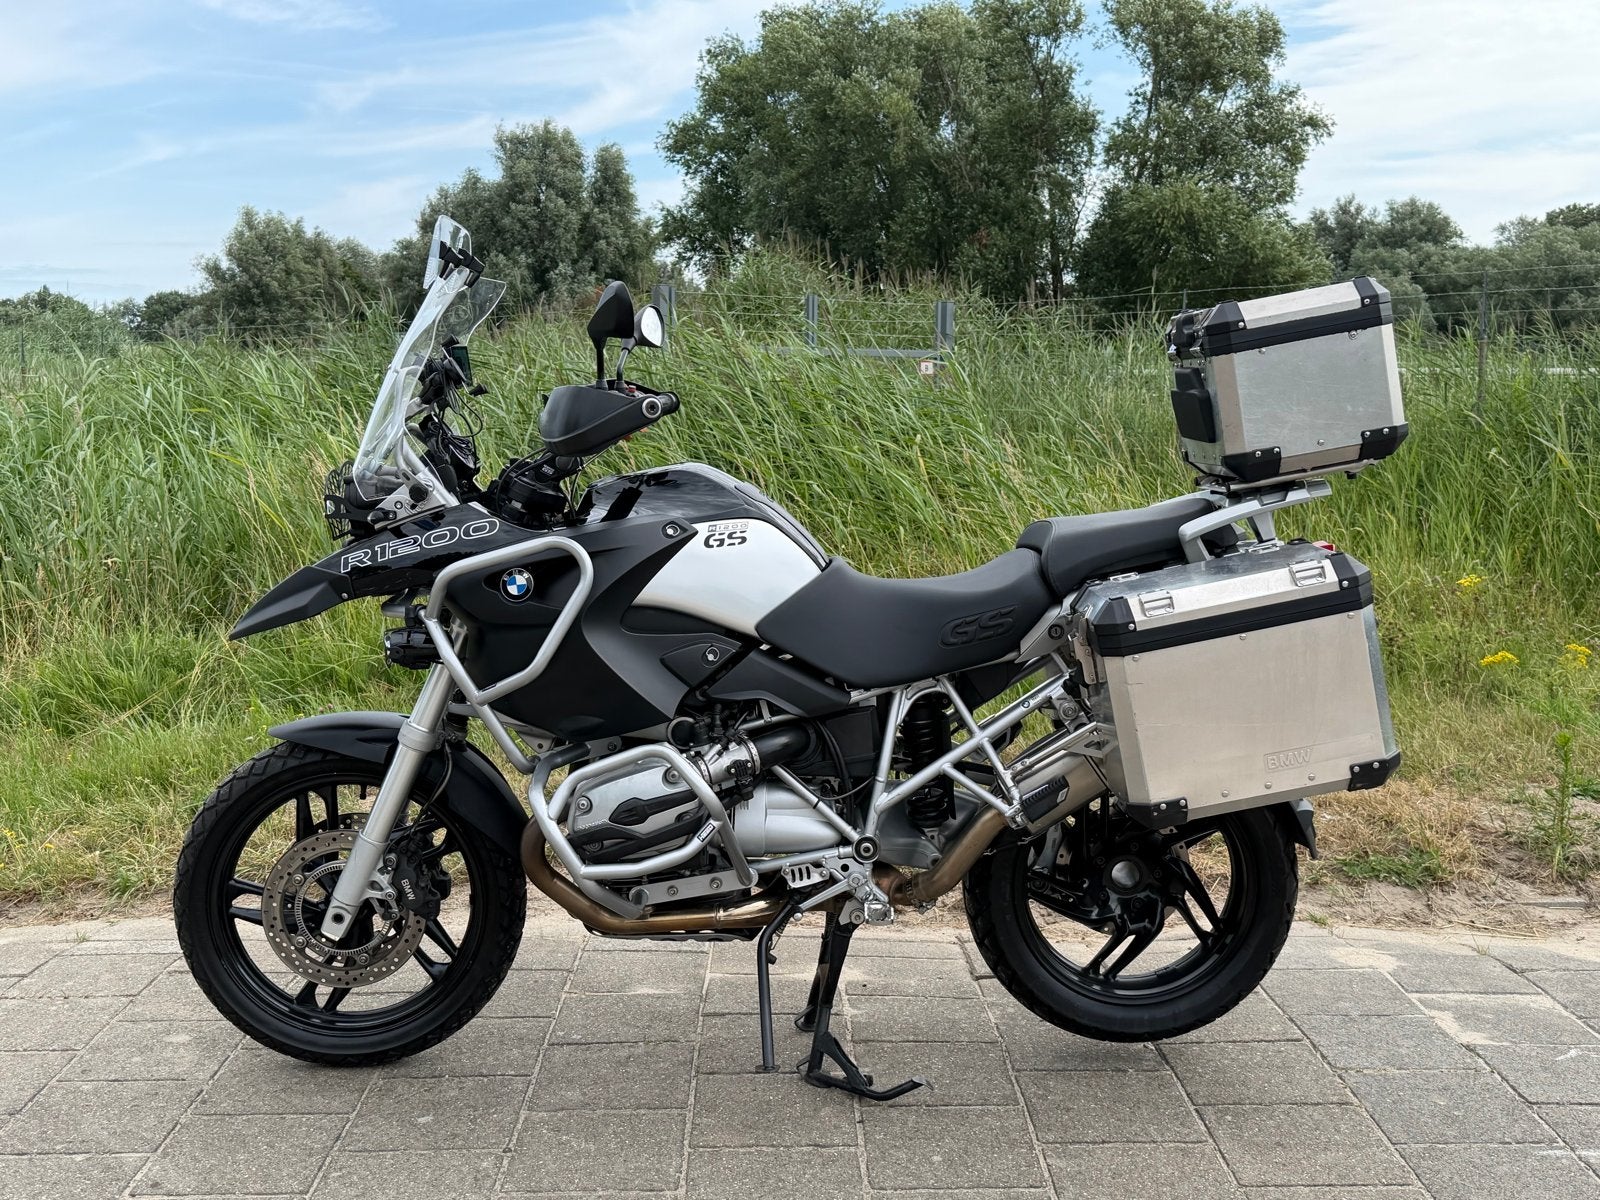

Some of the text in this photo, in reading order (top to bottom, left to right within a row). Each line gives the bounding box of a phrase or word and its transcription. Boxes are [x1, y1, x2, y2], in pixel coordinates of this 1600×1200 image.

[704, 530, 747, 548] GS
[940, 603, 1018, 646] GS
[1266, 748, 1313, 770] BMW
[401, 879, 416, 900] BMW
